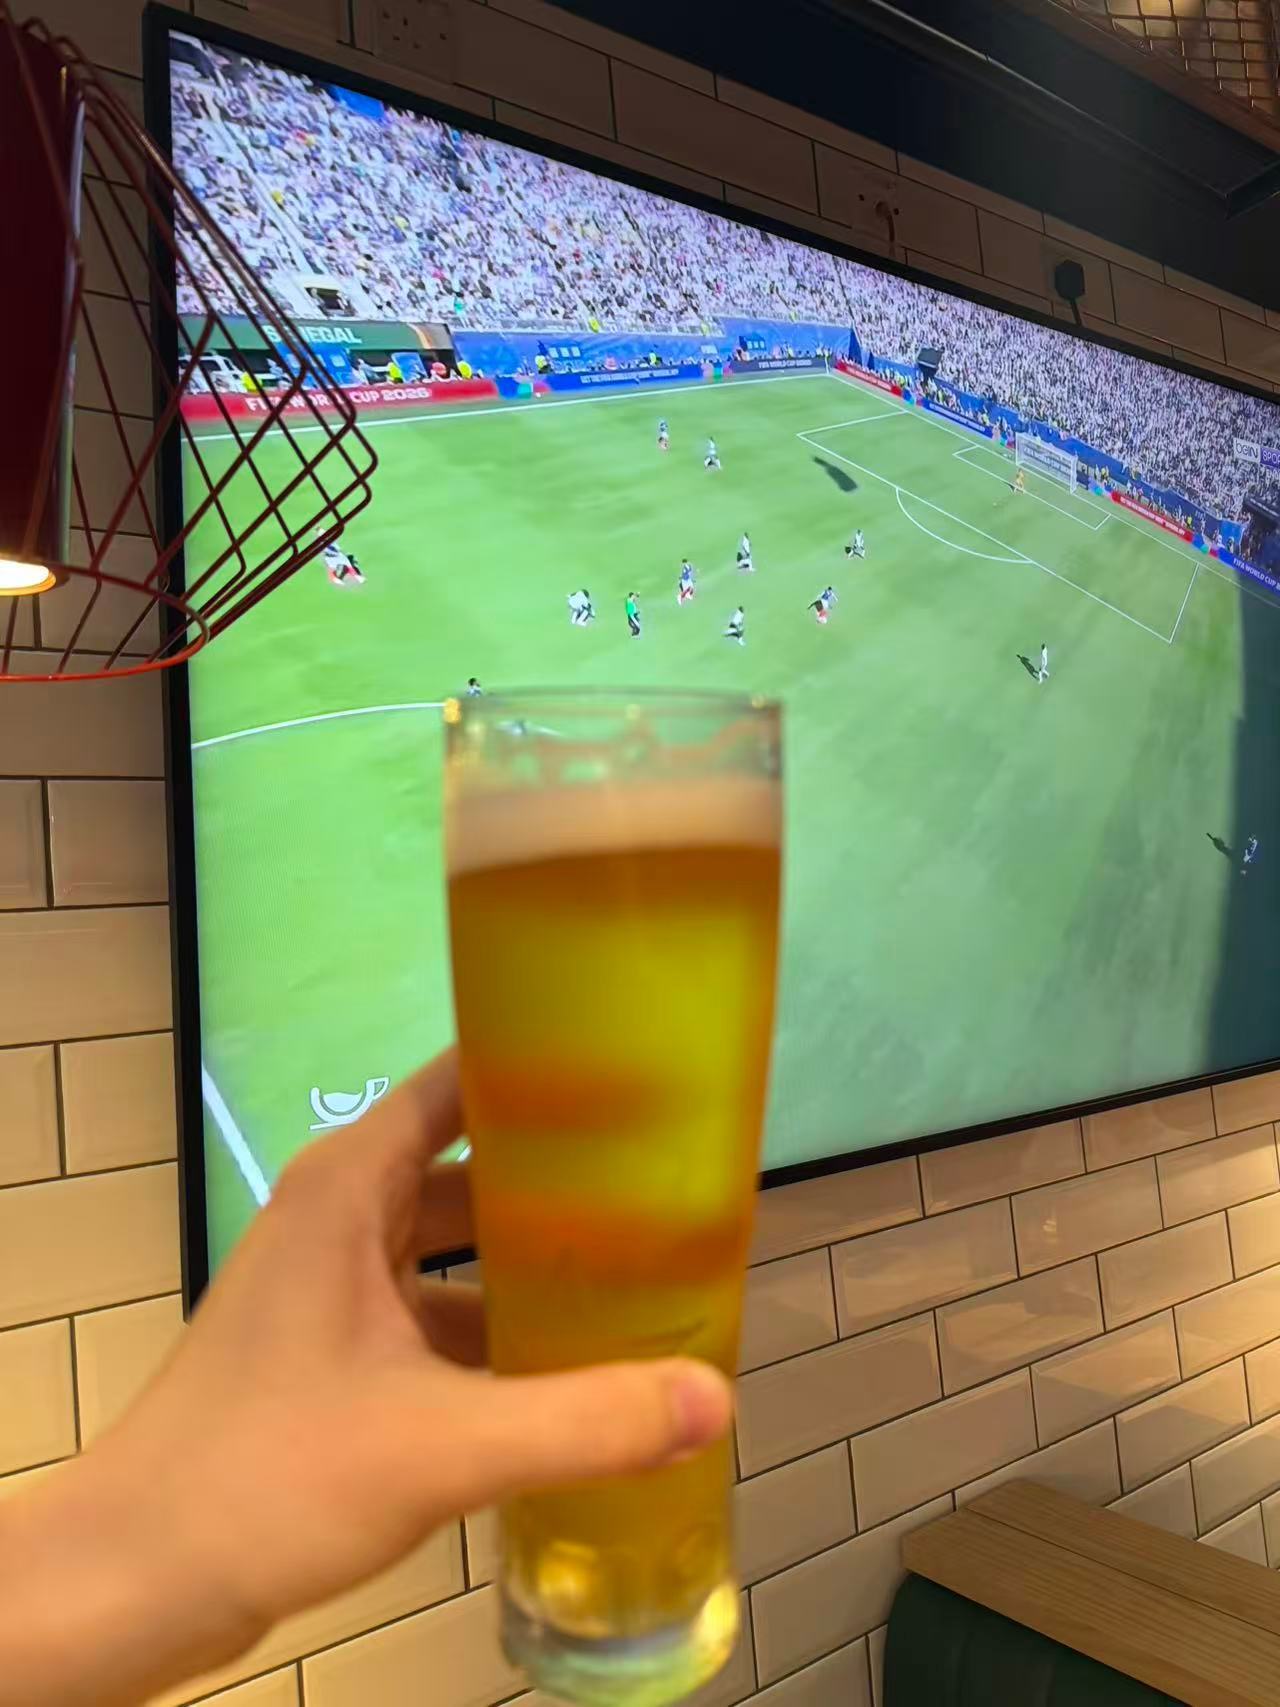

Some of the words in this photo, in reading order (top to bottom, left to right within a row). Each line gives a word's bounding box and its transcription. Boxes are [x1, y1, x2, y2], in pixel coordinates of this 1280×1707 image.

[262, 326, 362, 343] SNEGAL
[349, 390, 379, 403] CUP
[381, 387, 430, 400] 2026
[1233, 557, 1244, 569] FIFA
[1245, 563, 1264, 581] WORLD
[1265, 576, 1276, 587] CUP
